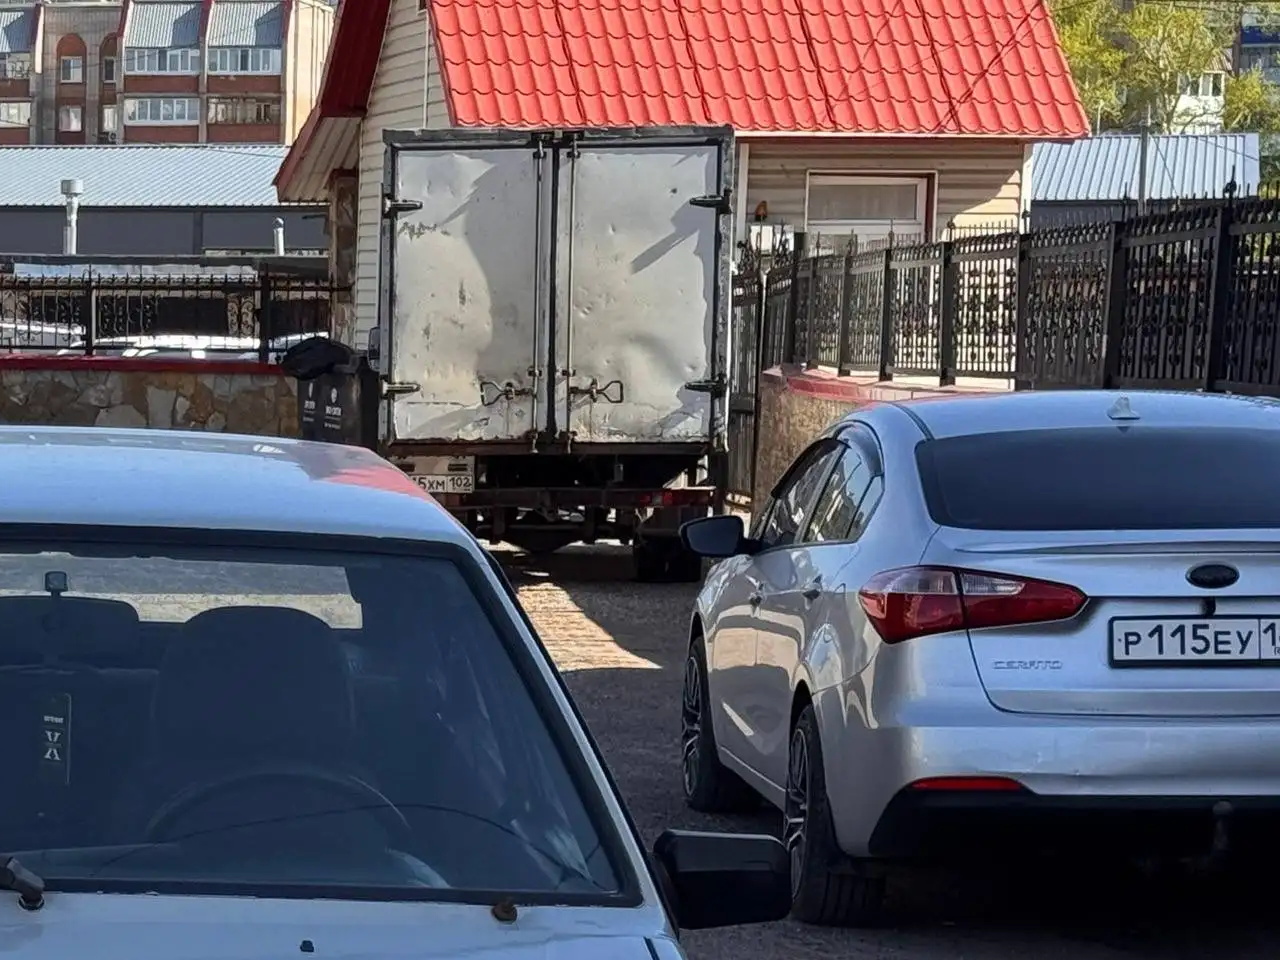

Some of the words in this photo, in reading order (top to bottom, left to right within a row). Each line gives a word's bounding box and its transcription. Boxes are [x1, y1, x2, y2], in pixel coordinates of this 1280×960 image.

[449, 477, 471, 488] 102
[1124, 623, 1254, 656] Р115ЕУ
[1262, 622, 1280, 647] 1
